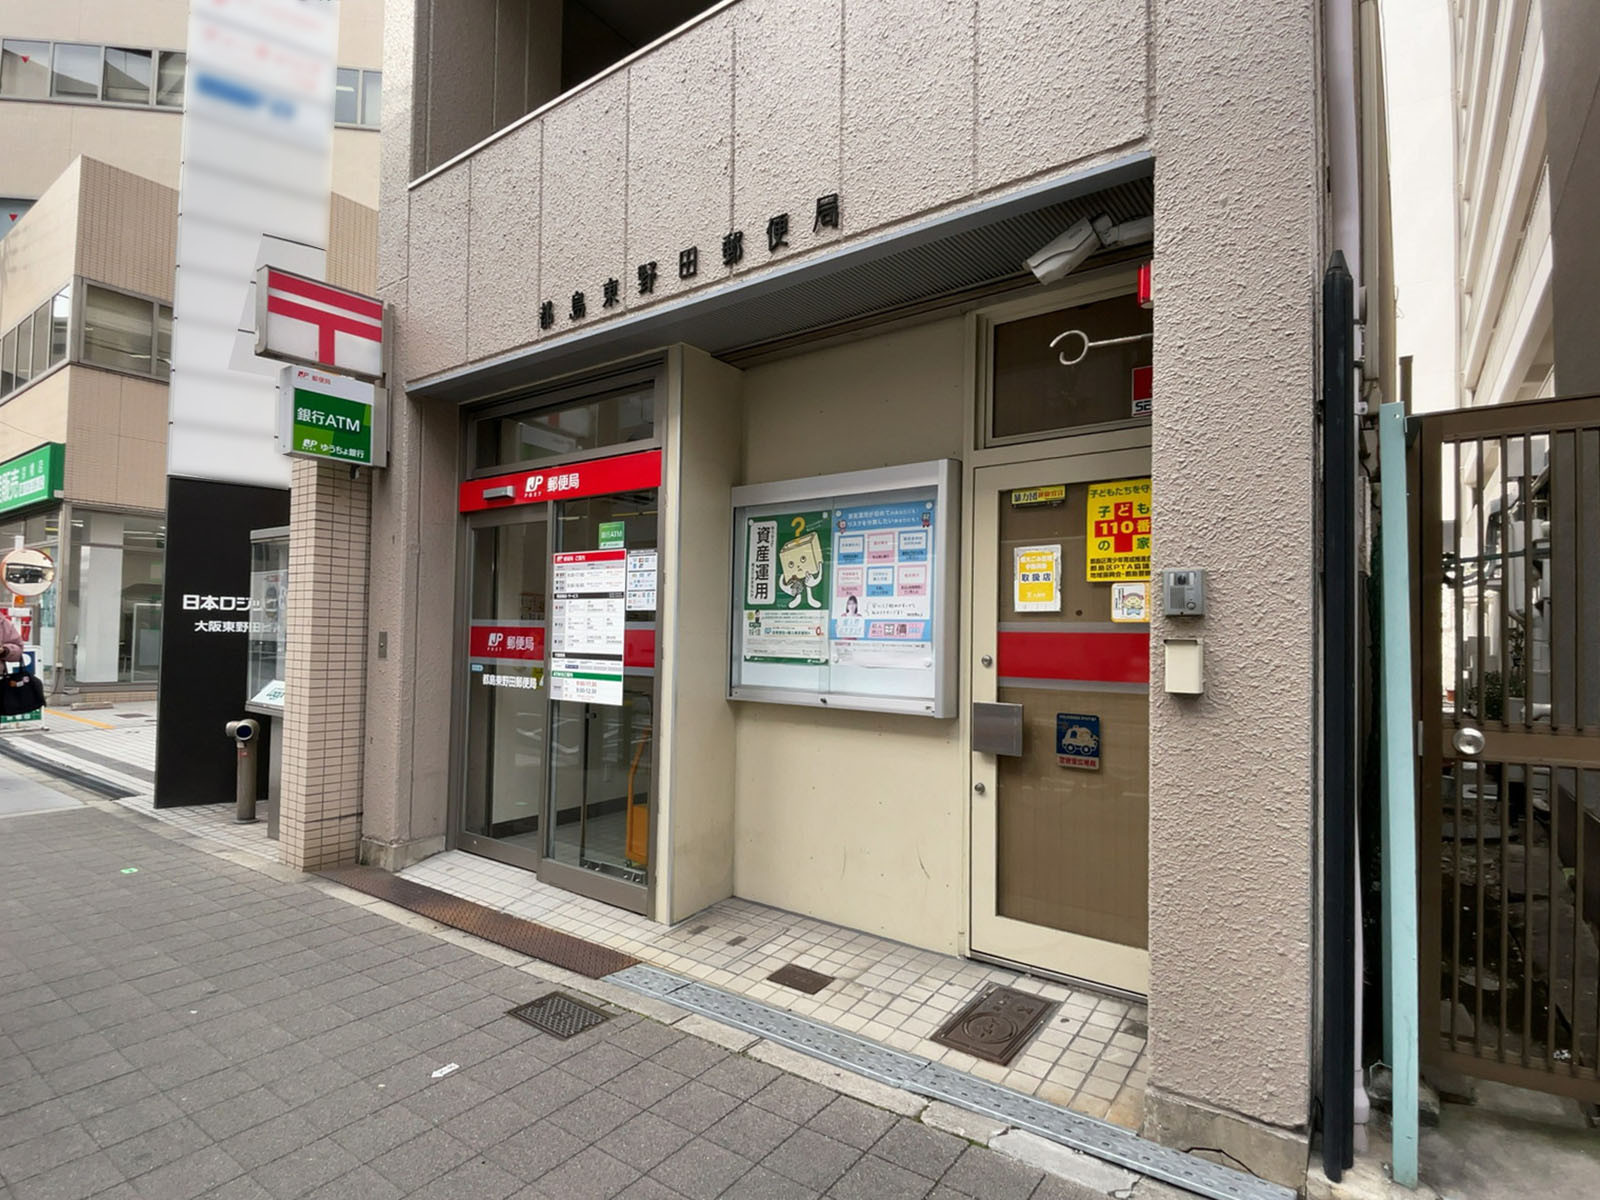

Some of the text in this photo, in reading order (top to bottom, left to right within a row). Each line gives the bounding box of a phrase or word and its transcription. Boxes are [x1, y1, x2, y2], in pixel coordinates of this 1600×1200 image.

[539, 193, 840, 330] 都島東野田郵便局
[297, 407, 360, 433] 銀行ATM
[320, 443, 365, 459] ゆうちょ銀行
[547, 472, 580, 492] 郵便局
[1098, 502, 1150, 518] 子ども
[1099, 519, 1150, 536] 110番
[1097, 537, 1150, 551] の家
[754, 526, 770, 600] 資産運用
[1021, 573, 1051, 582] 取扱店
[506, 636, 535, 651] 郵便局
